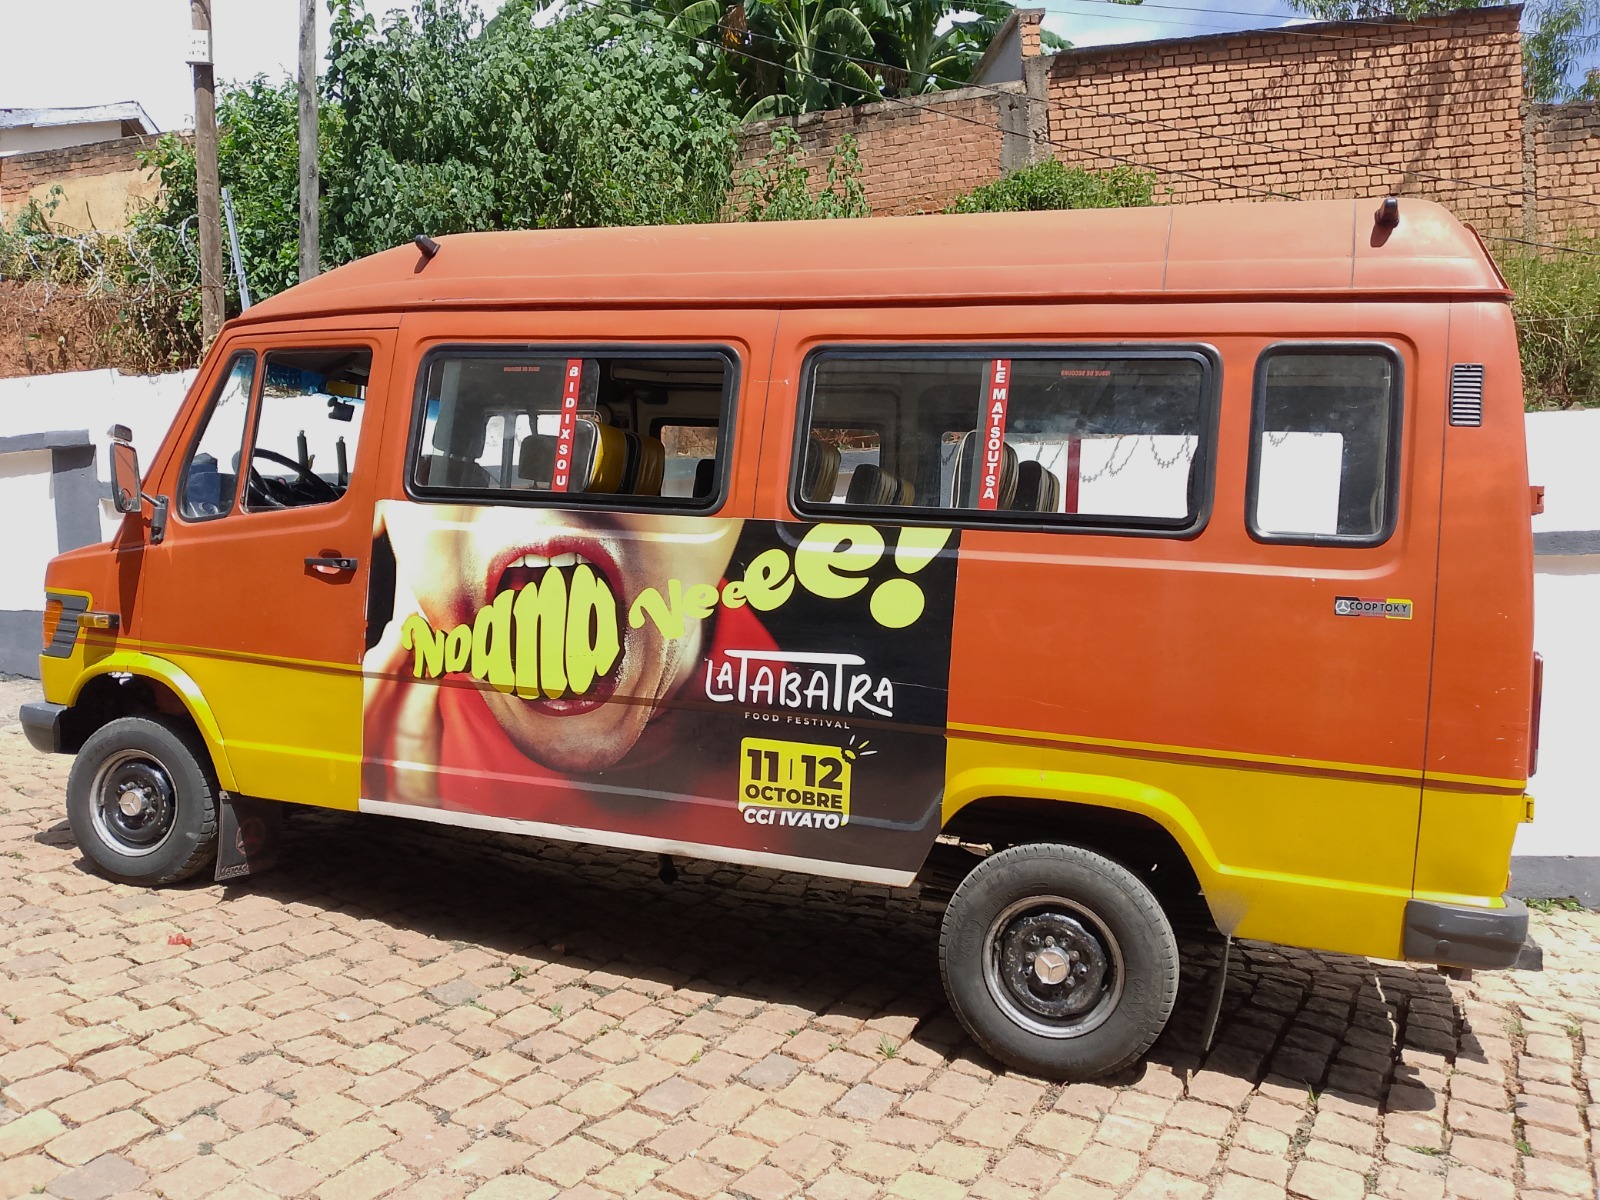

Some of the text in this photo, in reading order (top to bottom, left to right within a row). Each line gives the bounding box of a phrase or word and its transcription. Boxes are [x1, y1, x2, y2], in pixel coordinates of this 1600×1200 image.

[555, 366, 579, 486] BIDIXSOU
[983, 360, 1006, 499] LE MATSOUTSA
[744, 711, 850, 730] FOOD FESTIVAL
[747, 748, 843, 790] 11 12
[745, 784, 843, 809] OCTOBRE
[743, 808, 840, 830] CCI IVATO
